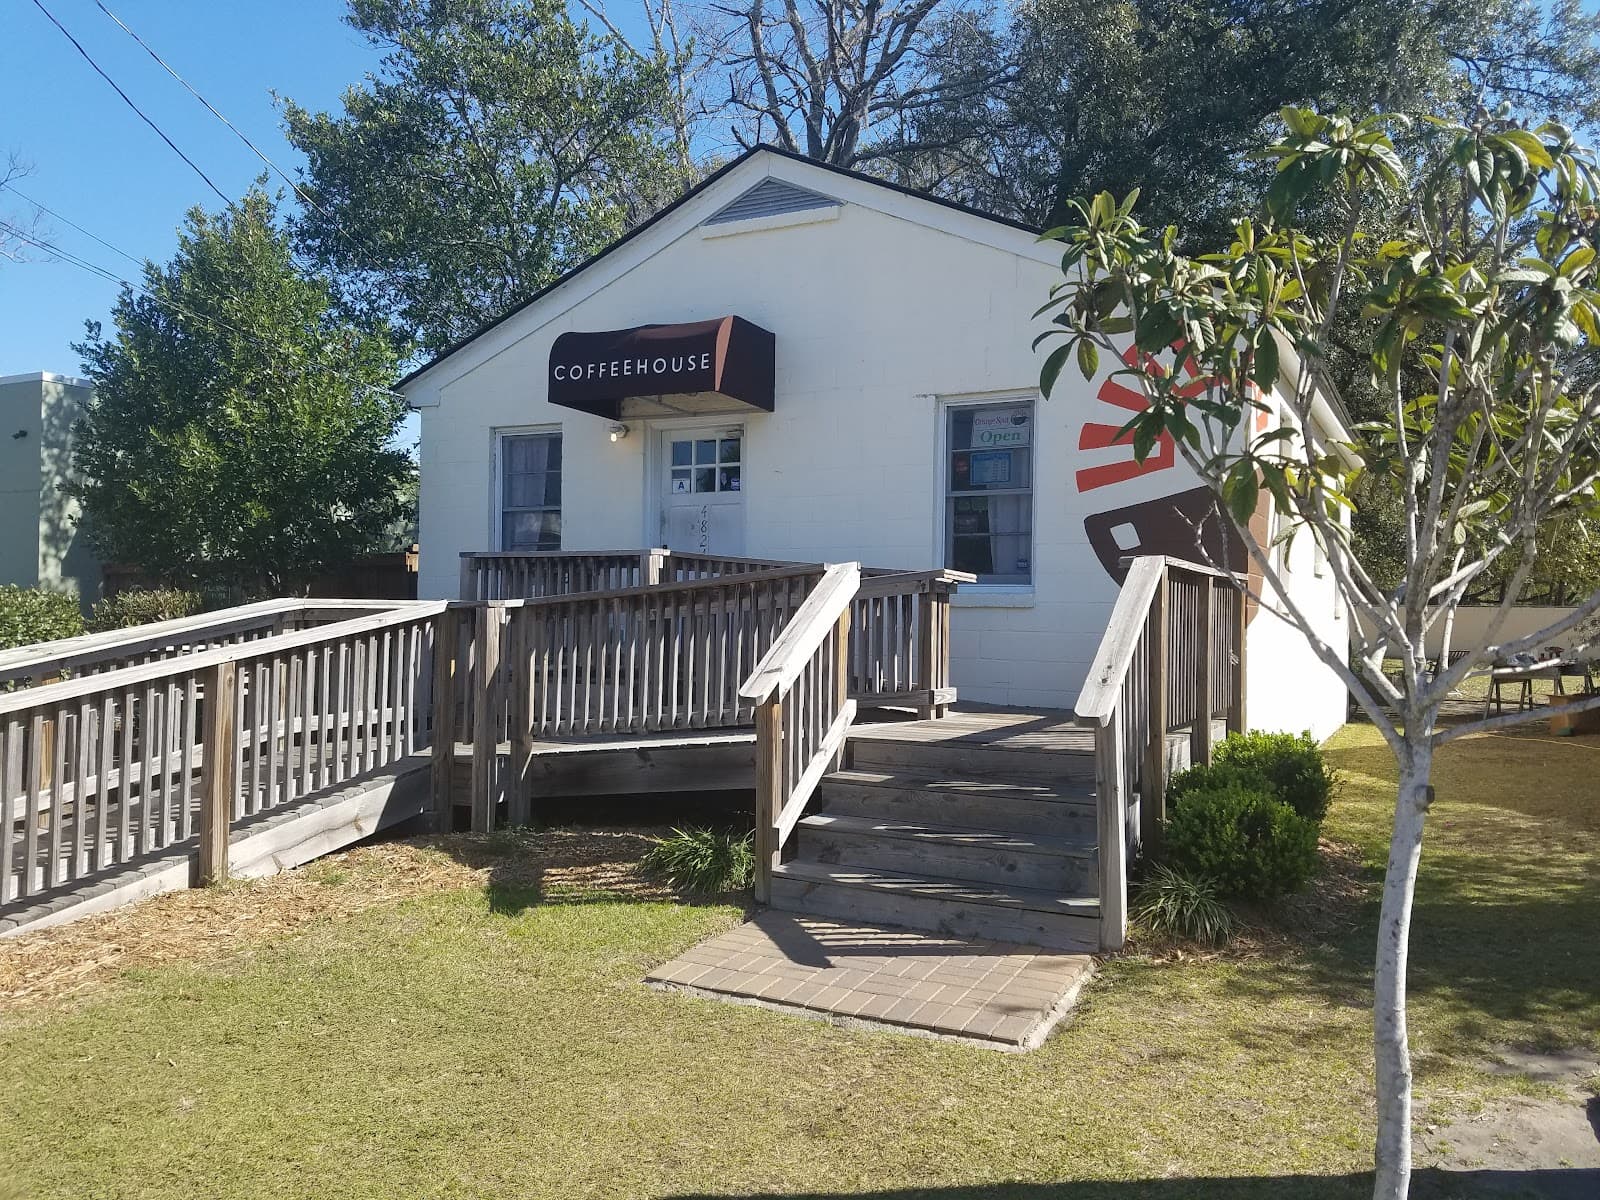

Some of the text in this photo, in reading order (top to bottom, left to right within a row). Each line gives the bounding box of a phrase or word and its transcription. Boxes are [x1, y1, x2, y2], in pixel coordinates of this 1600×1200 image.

[554, 353, 710, 380] COFFEEHOUSE
[980, 431, 1021, 445] Open
[678, 481, 685, 490] A
